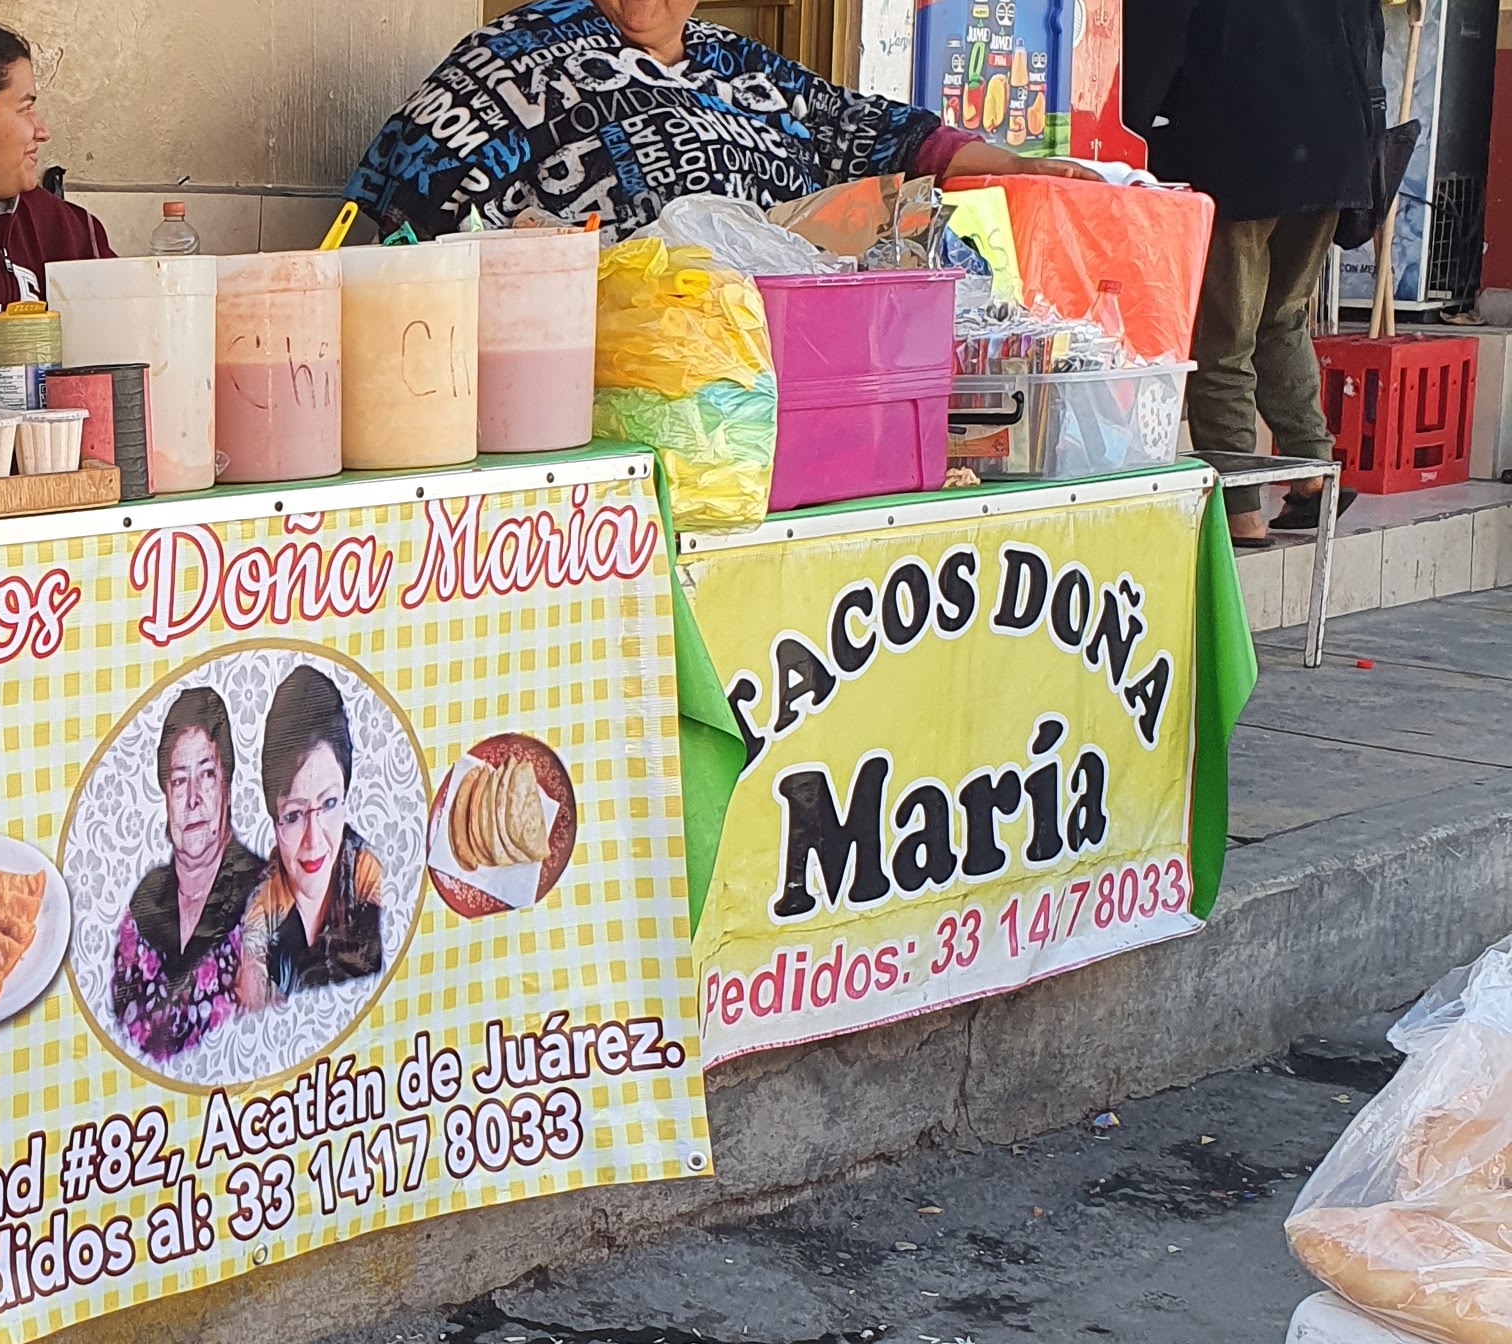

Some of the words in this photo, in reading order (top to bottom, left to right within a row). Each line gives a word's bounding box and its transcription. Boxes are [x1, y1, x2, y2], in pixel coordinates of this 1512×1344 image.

[130, 511, 393, 647] Doña
[727, 551, 977, 770] TACOS
[994, 549, 1170, 744] DOÑA
[774, 719, 1108, 918] María
[703, 940, 918, 1040] Pedidos:
[931, 909, 982, 975] 33
[60, 1105, 184, 1204] #82,
[197, 1054, 386, 1169] Acatlán
[397, 1030, 462, 1111] de
[473, 1009, 686, 1092] Juárez.
[146, 1176, 215, 1266] al:
[226, 1159, 296, 1243] 33
[307, 1113, 431, 1217] 1417
[443, 1087, 585, 1181] 8033
